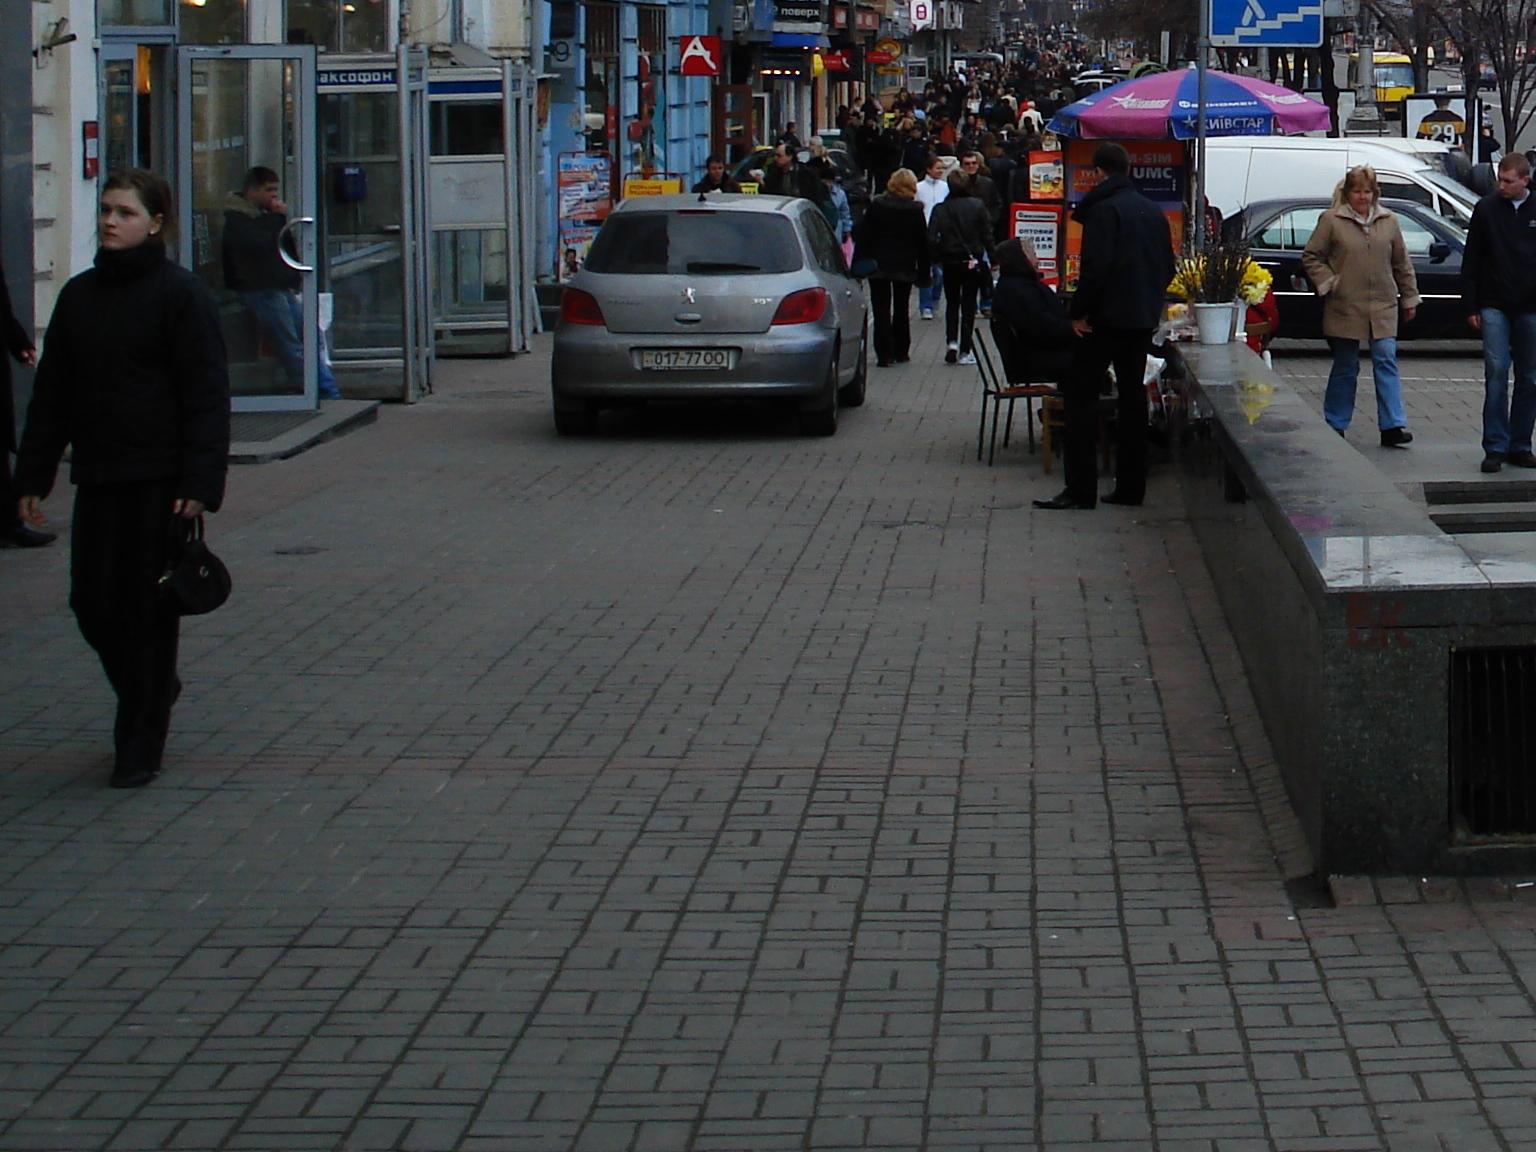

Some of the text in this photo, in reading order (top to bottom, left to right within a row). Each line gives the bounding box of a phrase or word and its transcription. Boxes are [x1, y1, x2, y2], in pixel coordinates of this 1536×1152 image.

[781, 8, 820, 18] поверх
[319, 70, 393, 84] аксофон
[1430, 123, 1456, 146] 29
[1132, 167, 1173, 179] UMC
